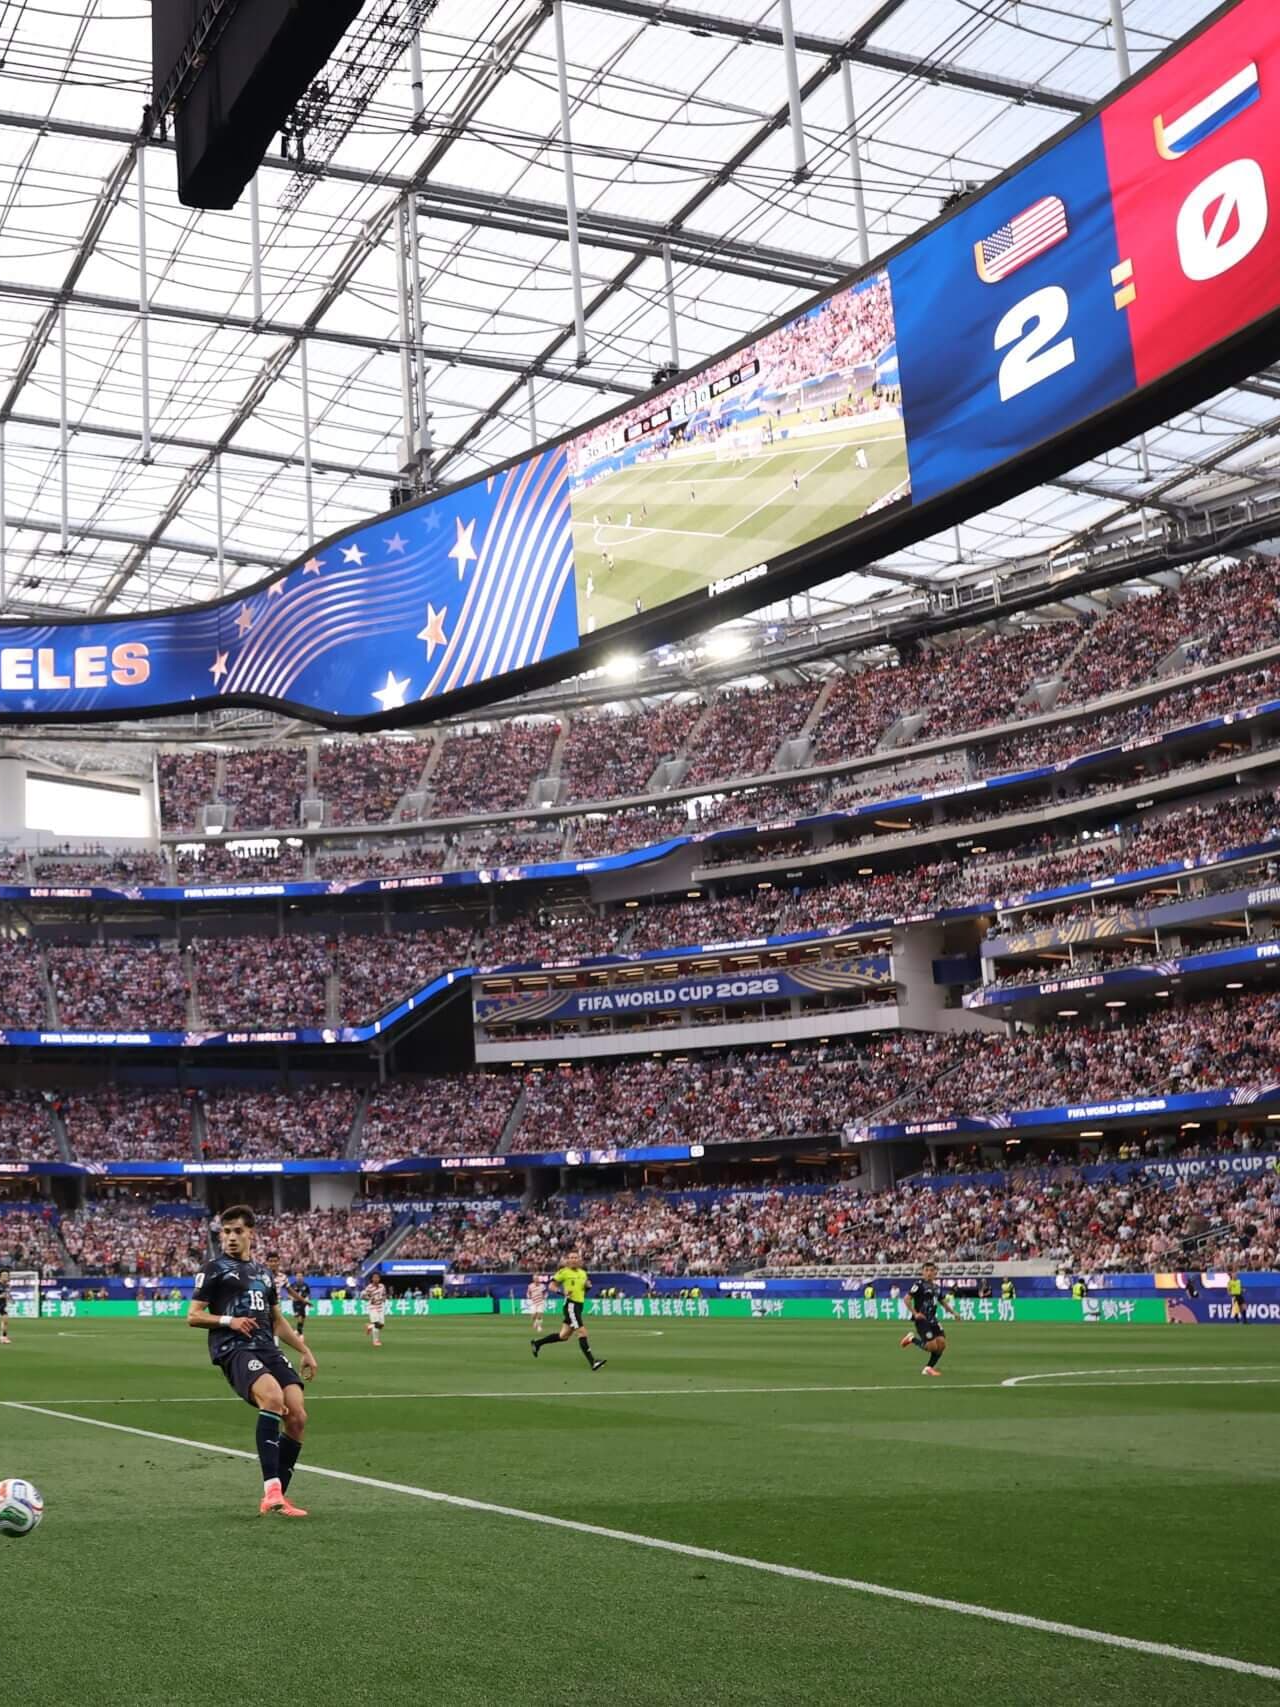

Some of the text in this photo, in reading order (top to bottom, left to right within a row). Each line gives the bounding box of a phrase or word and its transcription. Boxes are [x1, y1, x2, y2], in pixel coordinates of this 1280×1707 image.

[993, 285, 1075, 402] 2
[1176, 158, 1268, 281] 0
[579, 979, 779, 1011] FIFA WORLD CUP 2026
[1145, 1164, 1176, 1176] FFA
[1176, 1160, 1229, 1176] WOD
[1232, 1157, 1262, 1171] CUP
